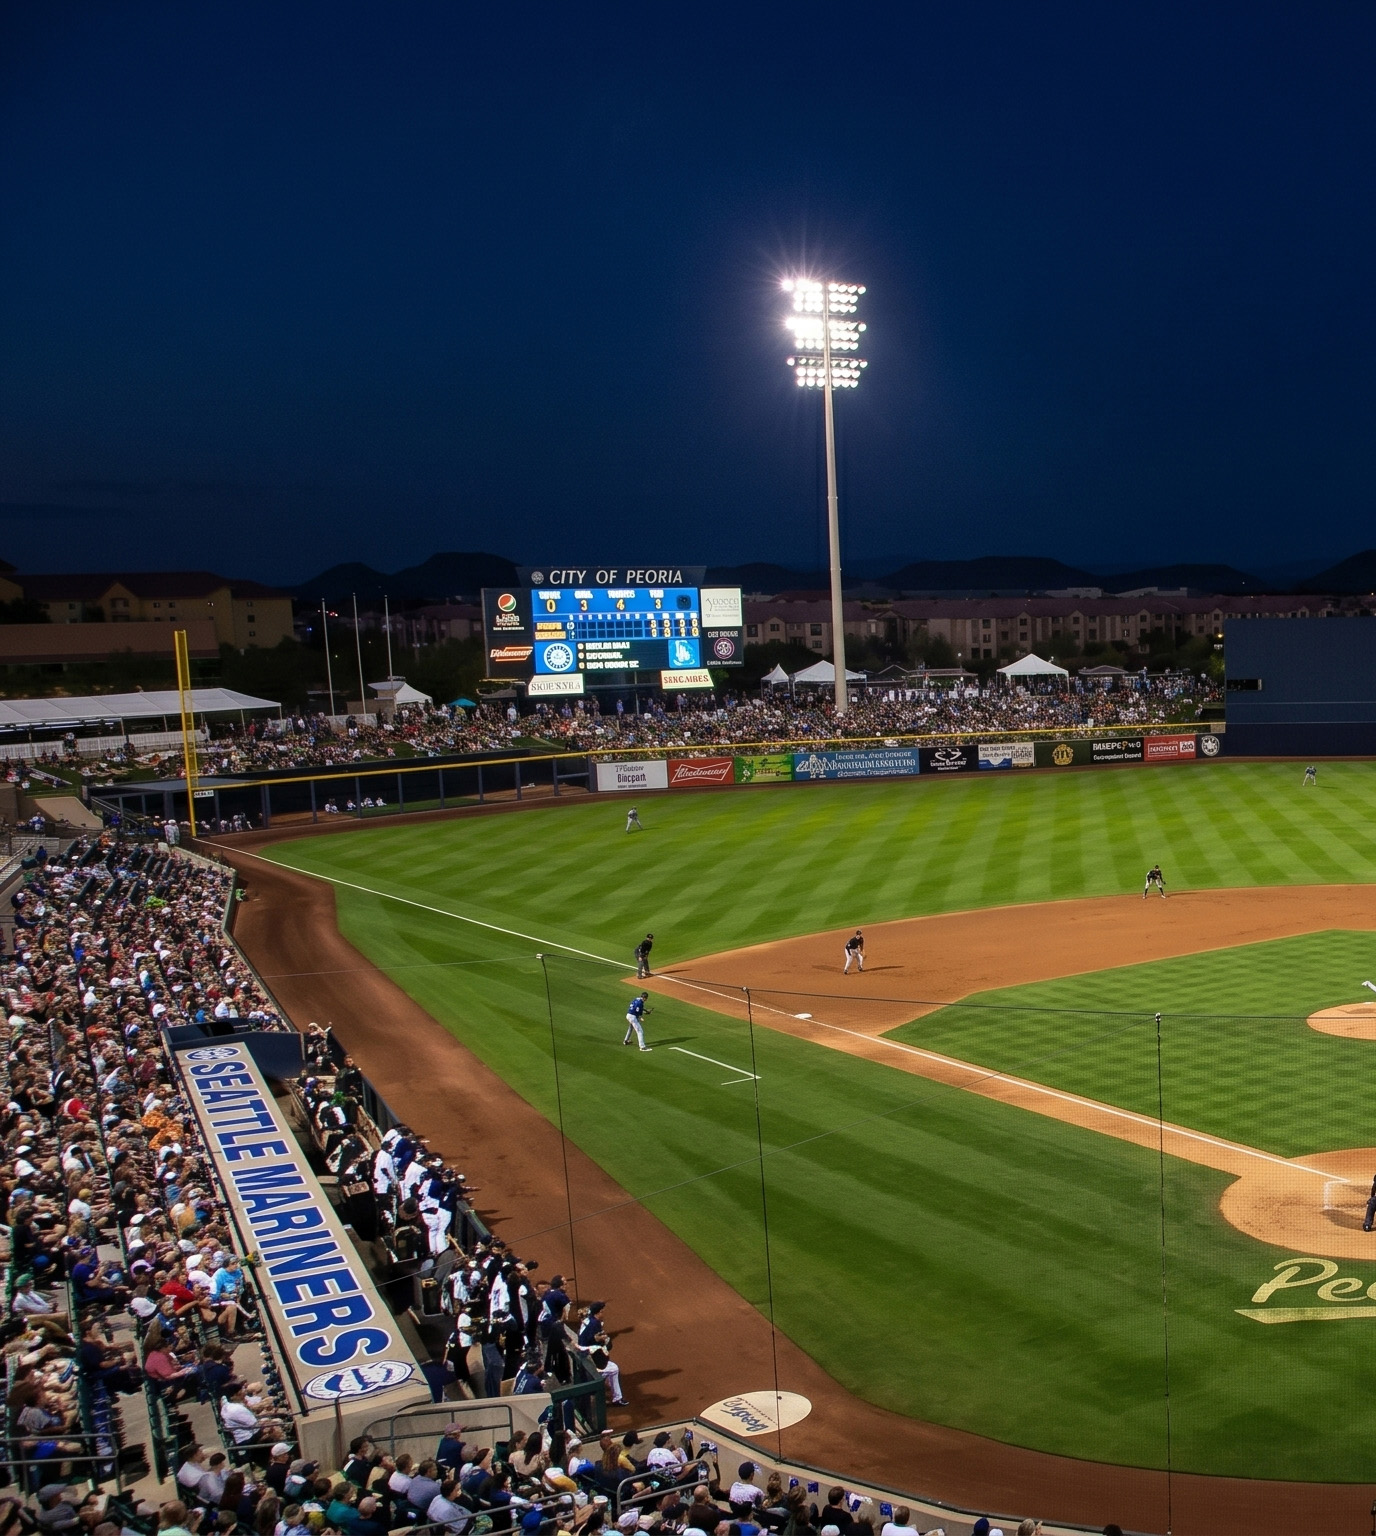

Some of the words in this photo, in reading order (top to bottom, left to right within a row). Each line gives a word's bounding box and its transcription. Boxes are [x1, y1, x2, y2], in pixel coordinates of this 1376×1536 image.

[549, 569, 586, 584] CITY
[595, 569, 617, 584] OF
[626, 569, 683, 583] PEORIA
[189, 1060, 290, 1163] SEATTLE
[231, 1162, 393, 1368] MARINERS
